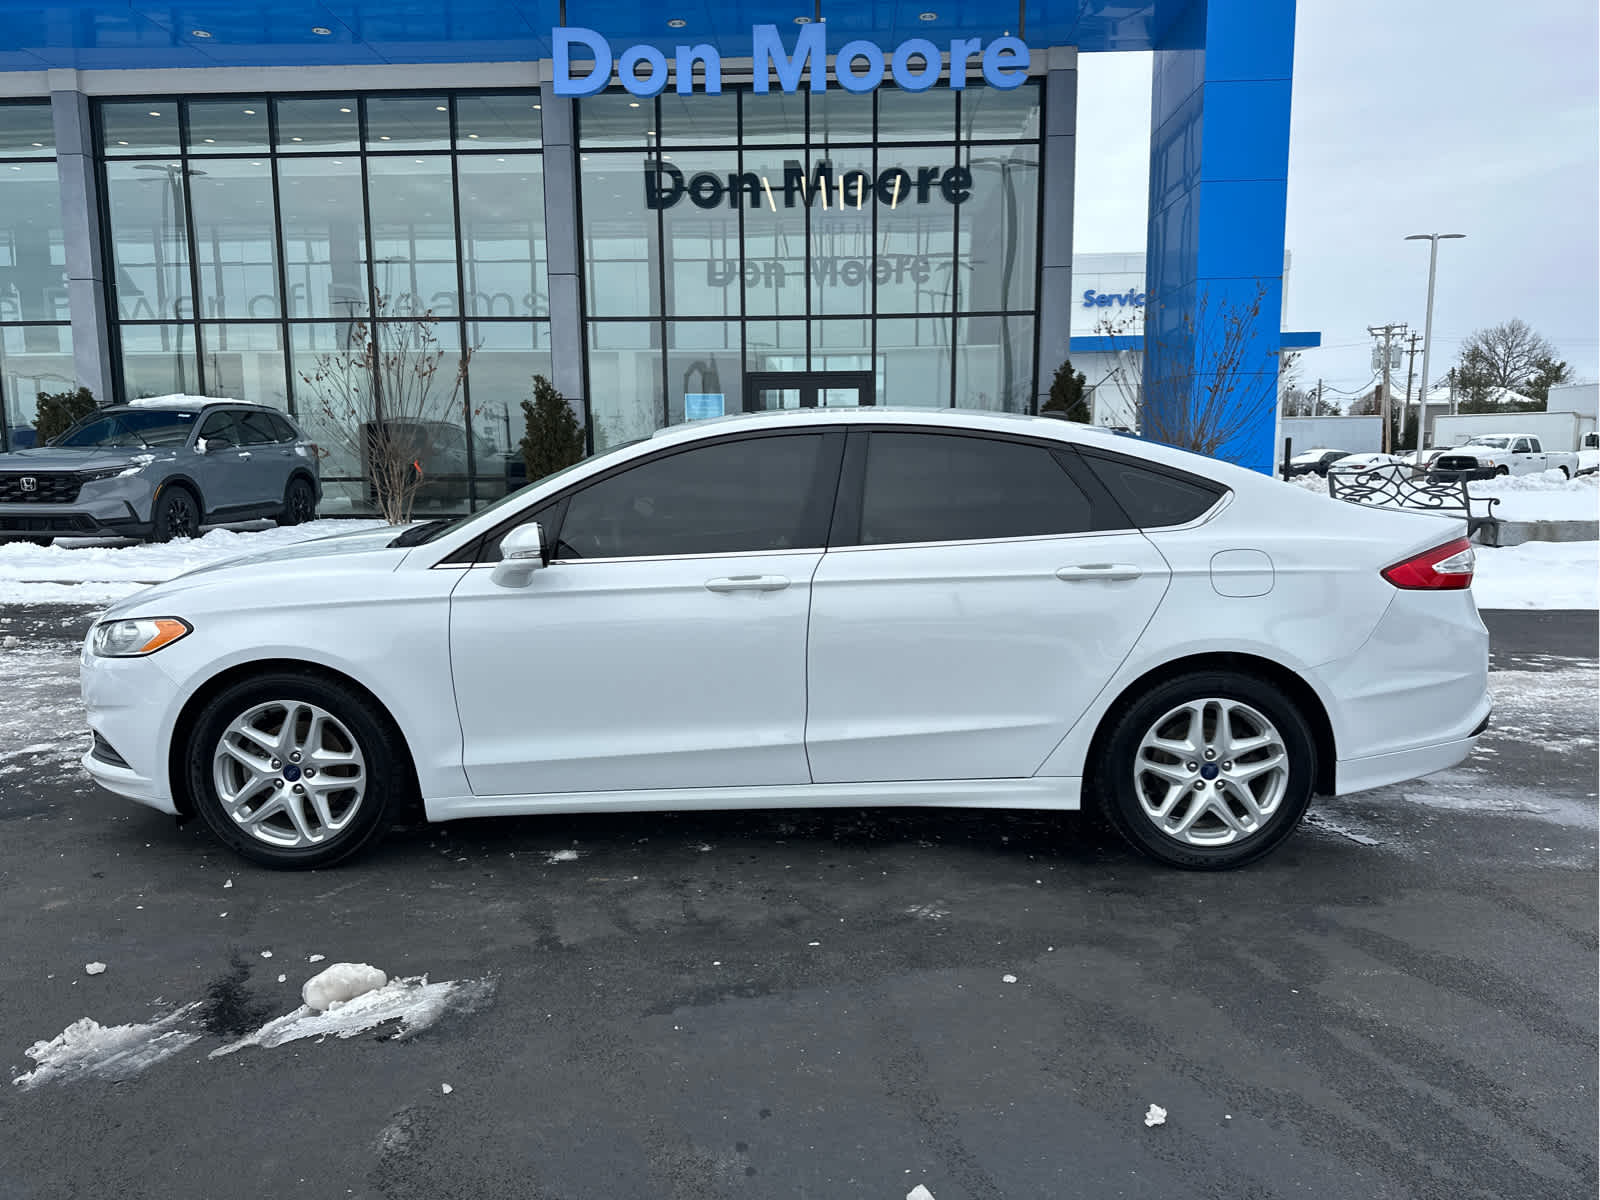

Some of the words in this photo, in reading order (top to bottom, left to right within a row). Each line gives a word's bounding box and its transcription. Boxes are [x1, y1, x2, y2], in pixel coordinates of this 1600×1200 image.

[551, 26, 722, 98] Don
[753, 22, 1031, 95] Moore
[644, 159, 761, 210] Don
[783, 158, 973, 208] Moore
[707, 258, 786, 289] Don
[803, 254, 931, 288] Moore
[1083, 288, 1146, 307] Servic
